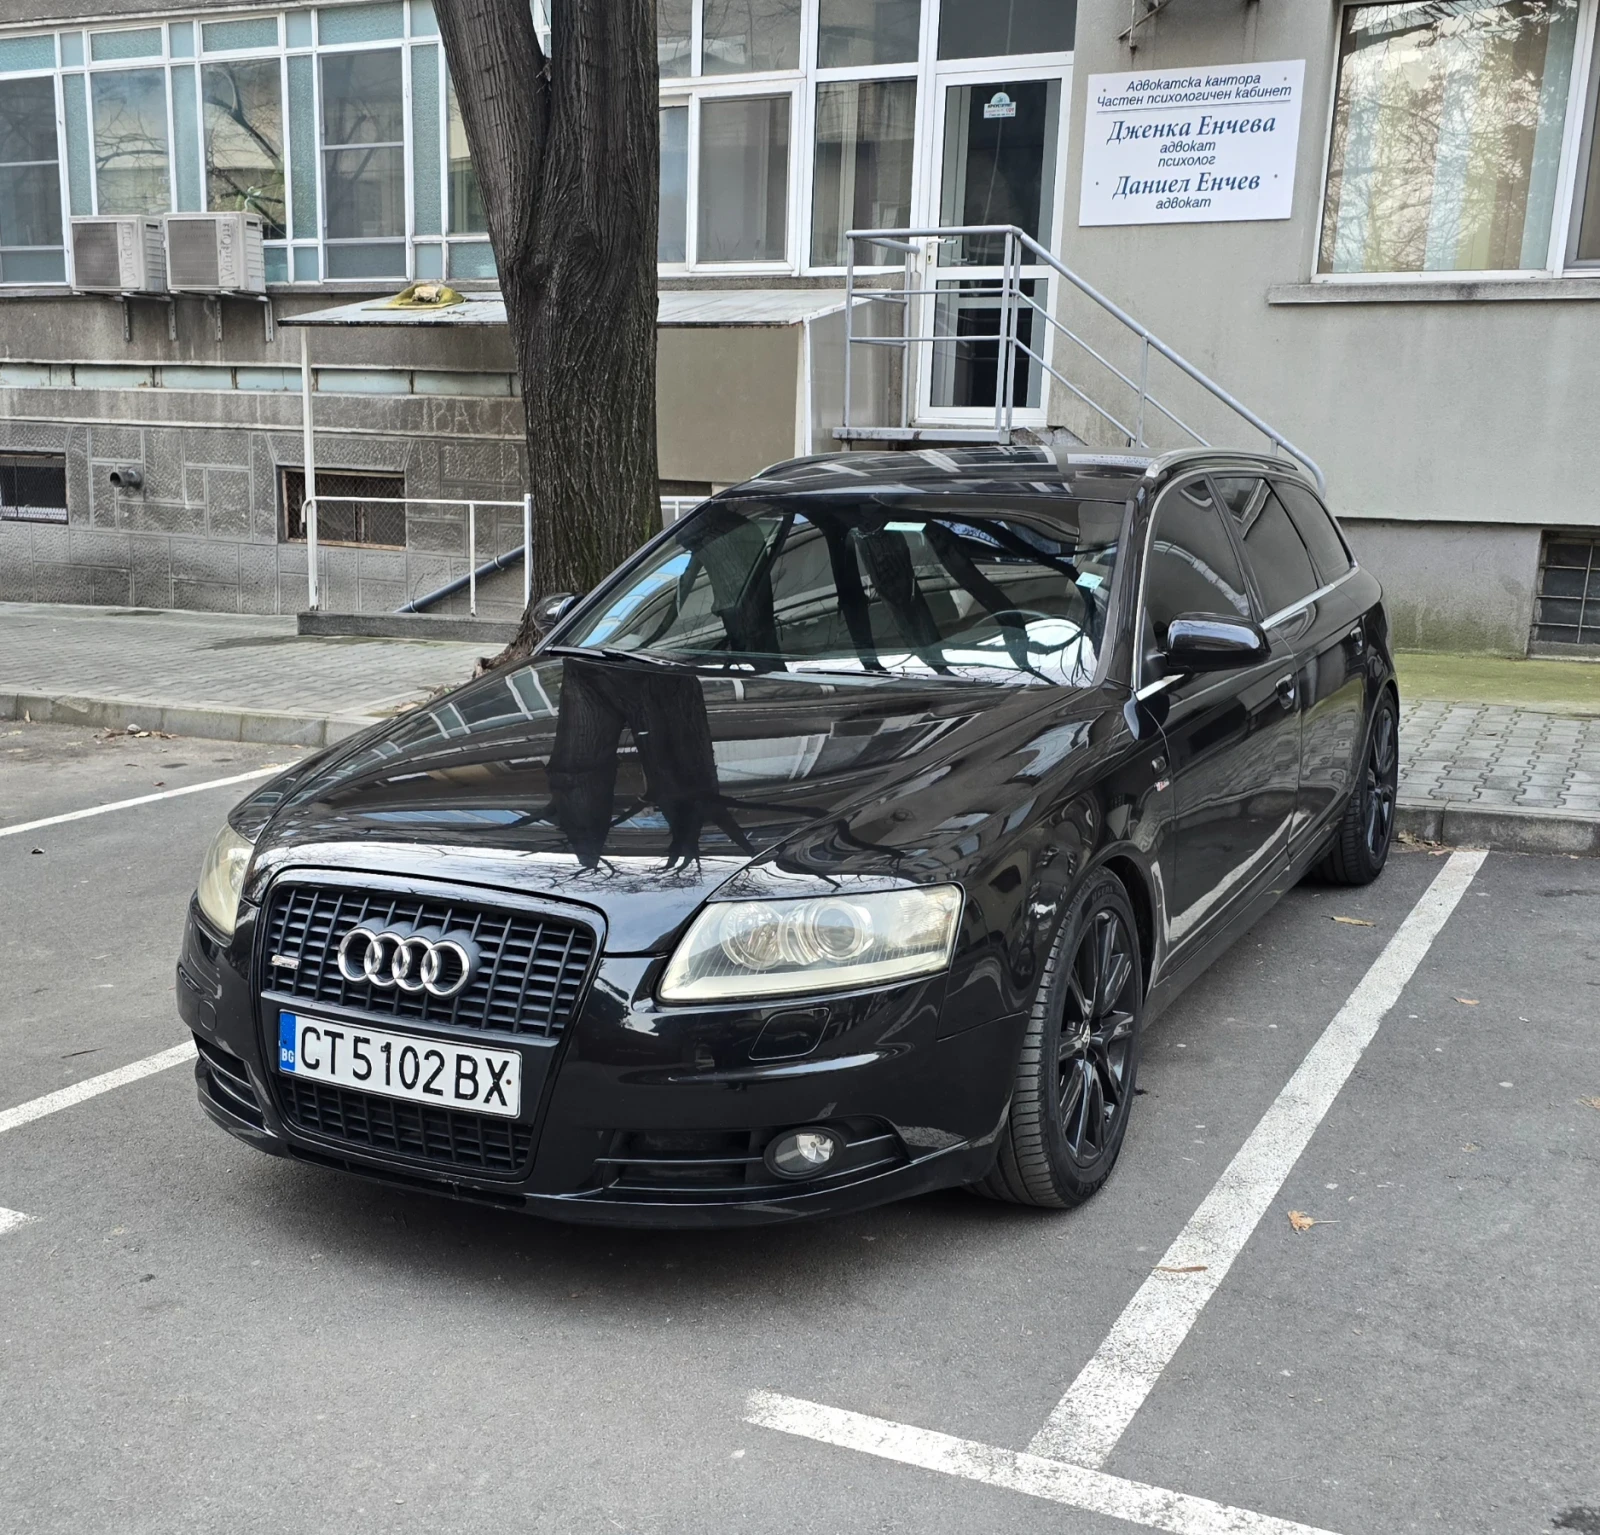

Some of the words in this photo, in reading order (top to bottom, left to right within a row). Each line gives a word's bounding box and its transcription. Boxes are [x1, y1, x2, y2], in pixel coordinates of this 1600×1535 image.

[1126, 77, 1202, 93] Адвокатска
[1204, 74, 1261, 88] кантора
[1097, 95, 1144, 108] Частен
[1146, 90, 1232, 105] психологичен
[1234, 85, 1292, 99] кабинет
[1106, 120, 1192, 145] Дженка
[1196, 115, 1276, 136] Енчева
[1159, 140, 1216, 154] адвокат
[1157, 155, 1216, 168] психолог
[1111, 175, 1191, 200] Даниел
[1195, 172, 1261, 192] Енчев
[1155, 197, 1212, 210] адвокат
[281, 1048, 295, 1063] BG
